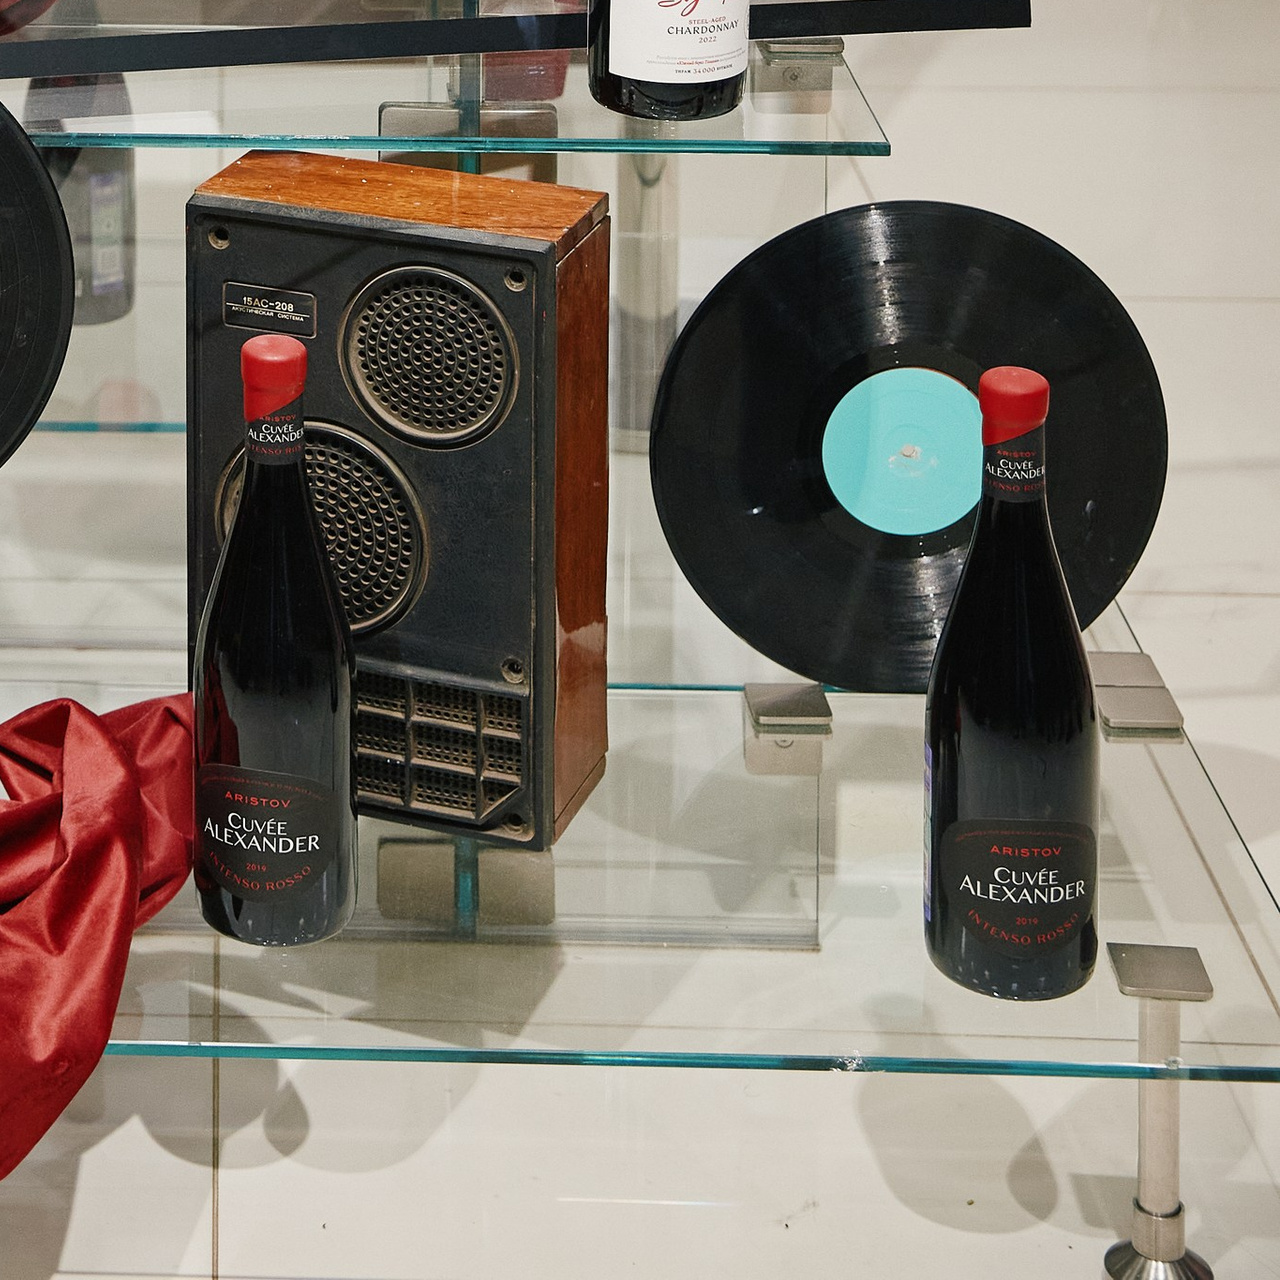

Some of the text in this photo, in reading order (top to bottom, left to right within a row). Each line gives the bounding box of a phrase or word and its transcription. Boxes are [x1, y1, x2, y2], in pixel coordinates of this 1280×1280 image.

[667, 19, 739, 35] CHARDONNAY
[698, 36, 717, 44] 2022
[277, 313, 304, 322] СИСТЕМА
[262, 423, 294, 434] CUVÉE
[999, 458, 1034, 471] CUVÉE
[225, 790, 291, 808] ARISTOV
[227, 812, 287, 836] CUVÉE
[204, 817, 320, 854] ALEXANDER
[990, 844, 1062, 858] ARISTOV
[209, 851, 311, 891] INTENSO ROSSO
[993, 866, 1059, 886] CUVÉE
[959, 874, 1086, 904] ALEXANDER
[968, 908, 1080, 946] INTENSO ROSSO
